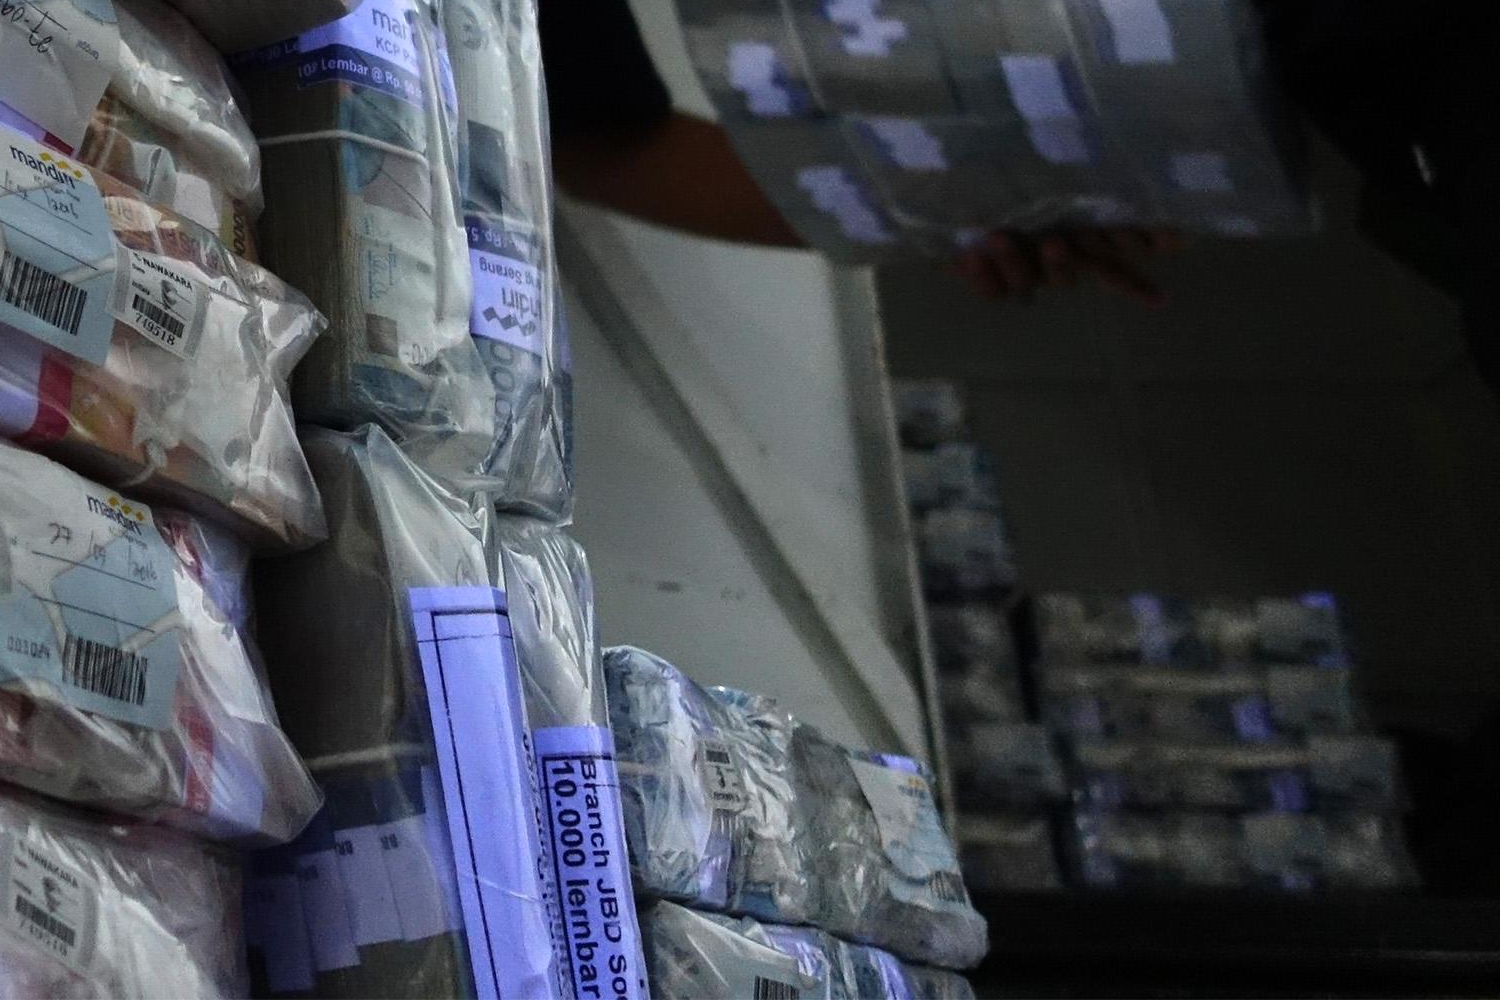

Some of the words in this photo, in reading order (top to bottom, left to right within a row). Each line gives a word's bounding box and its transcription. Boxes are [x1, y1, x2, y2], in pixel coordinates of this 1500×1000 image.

[321, 57, 370, 78] Lembar
[371, 66, 384, 84] @
[9, 145, 77, 190] mandiri
[141, 257, 193, 292] NAWAKARA
[479, 256, 522, 284] Serang
[134, 312, 177, 347] 749518
[86, 495, 143, 537] mandiri
[551, 761, 587, 868] 10.000
[580, 756, 610, 868] Branch
